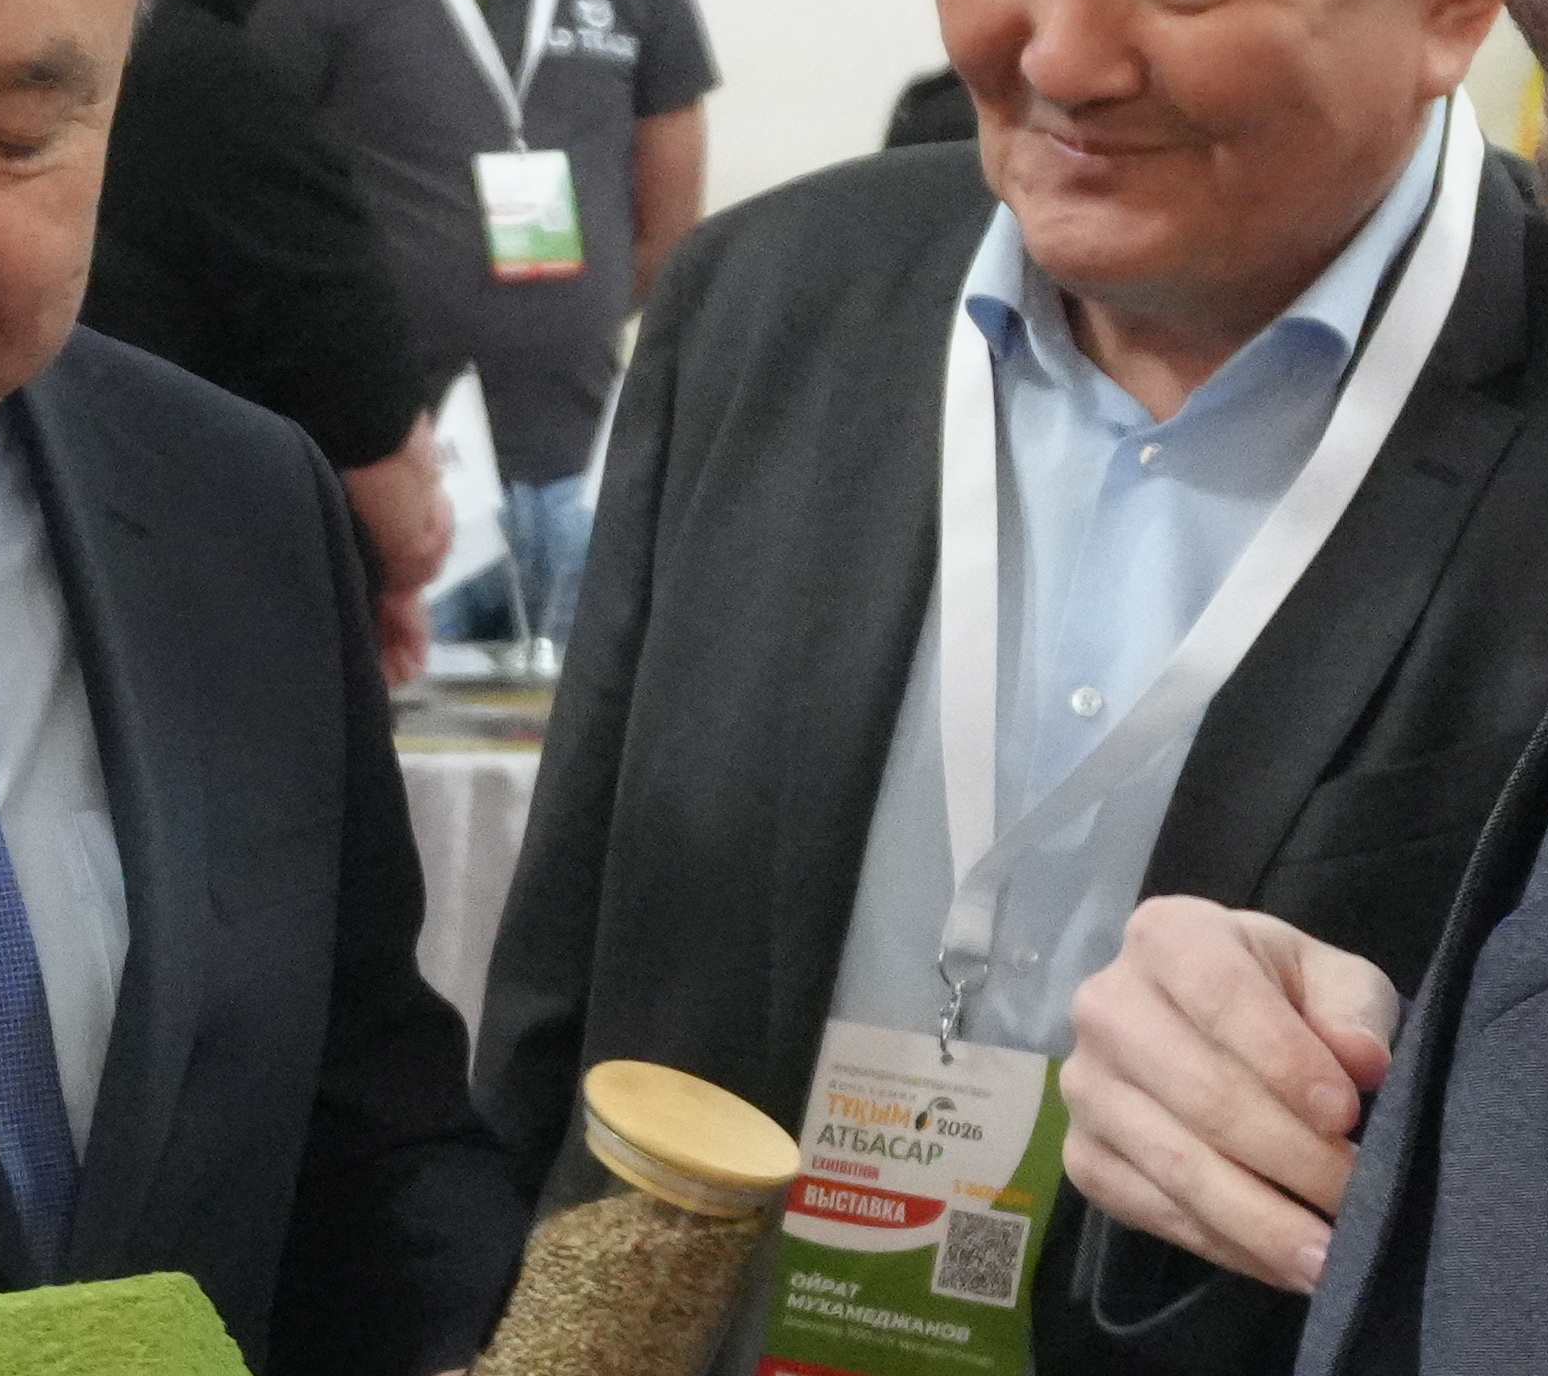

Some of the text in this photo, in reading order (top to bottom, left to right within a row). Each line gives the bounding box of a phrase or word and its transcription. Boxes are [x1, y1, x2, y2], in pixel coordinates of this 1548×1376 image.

[816, 1123, 944, 1165] АТБАСАР
[937, 1117, 983, 1141] 2026
[805, 1184, 907, 1224] ВЫСТАВКА
